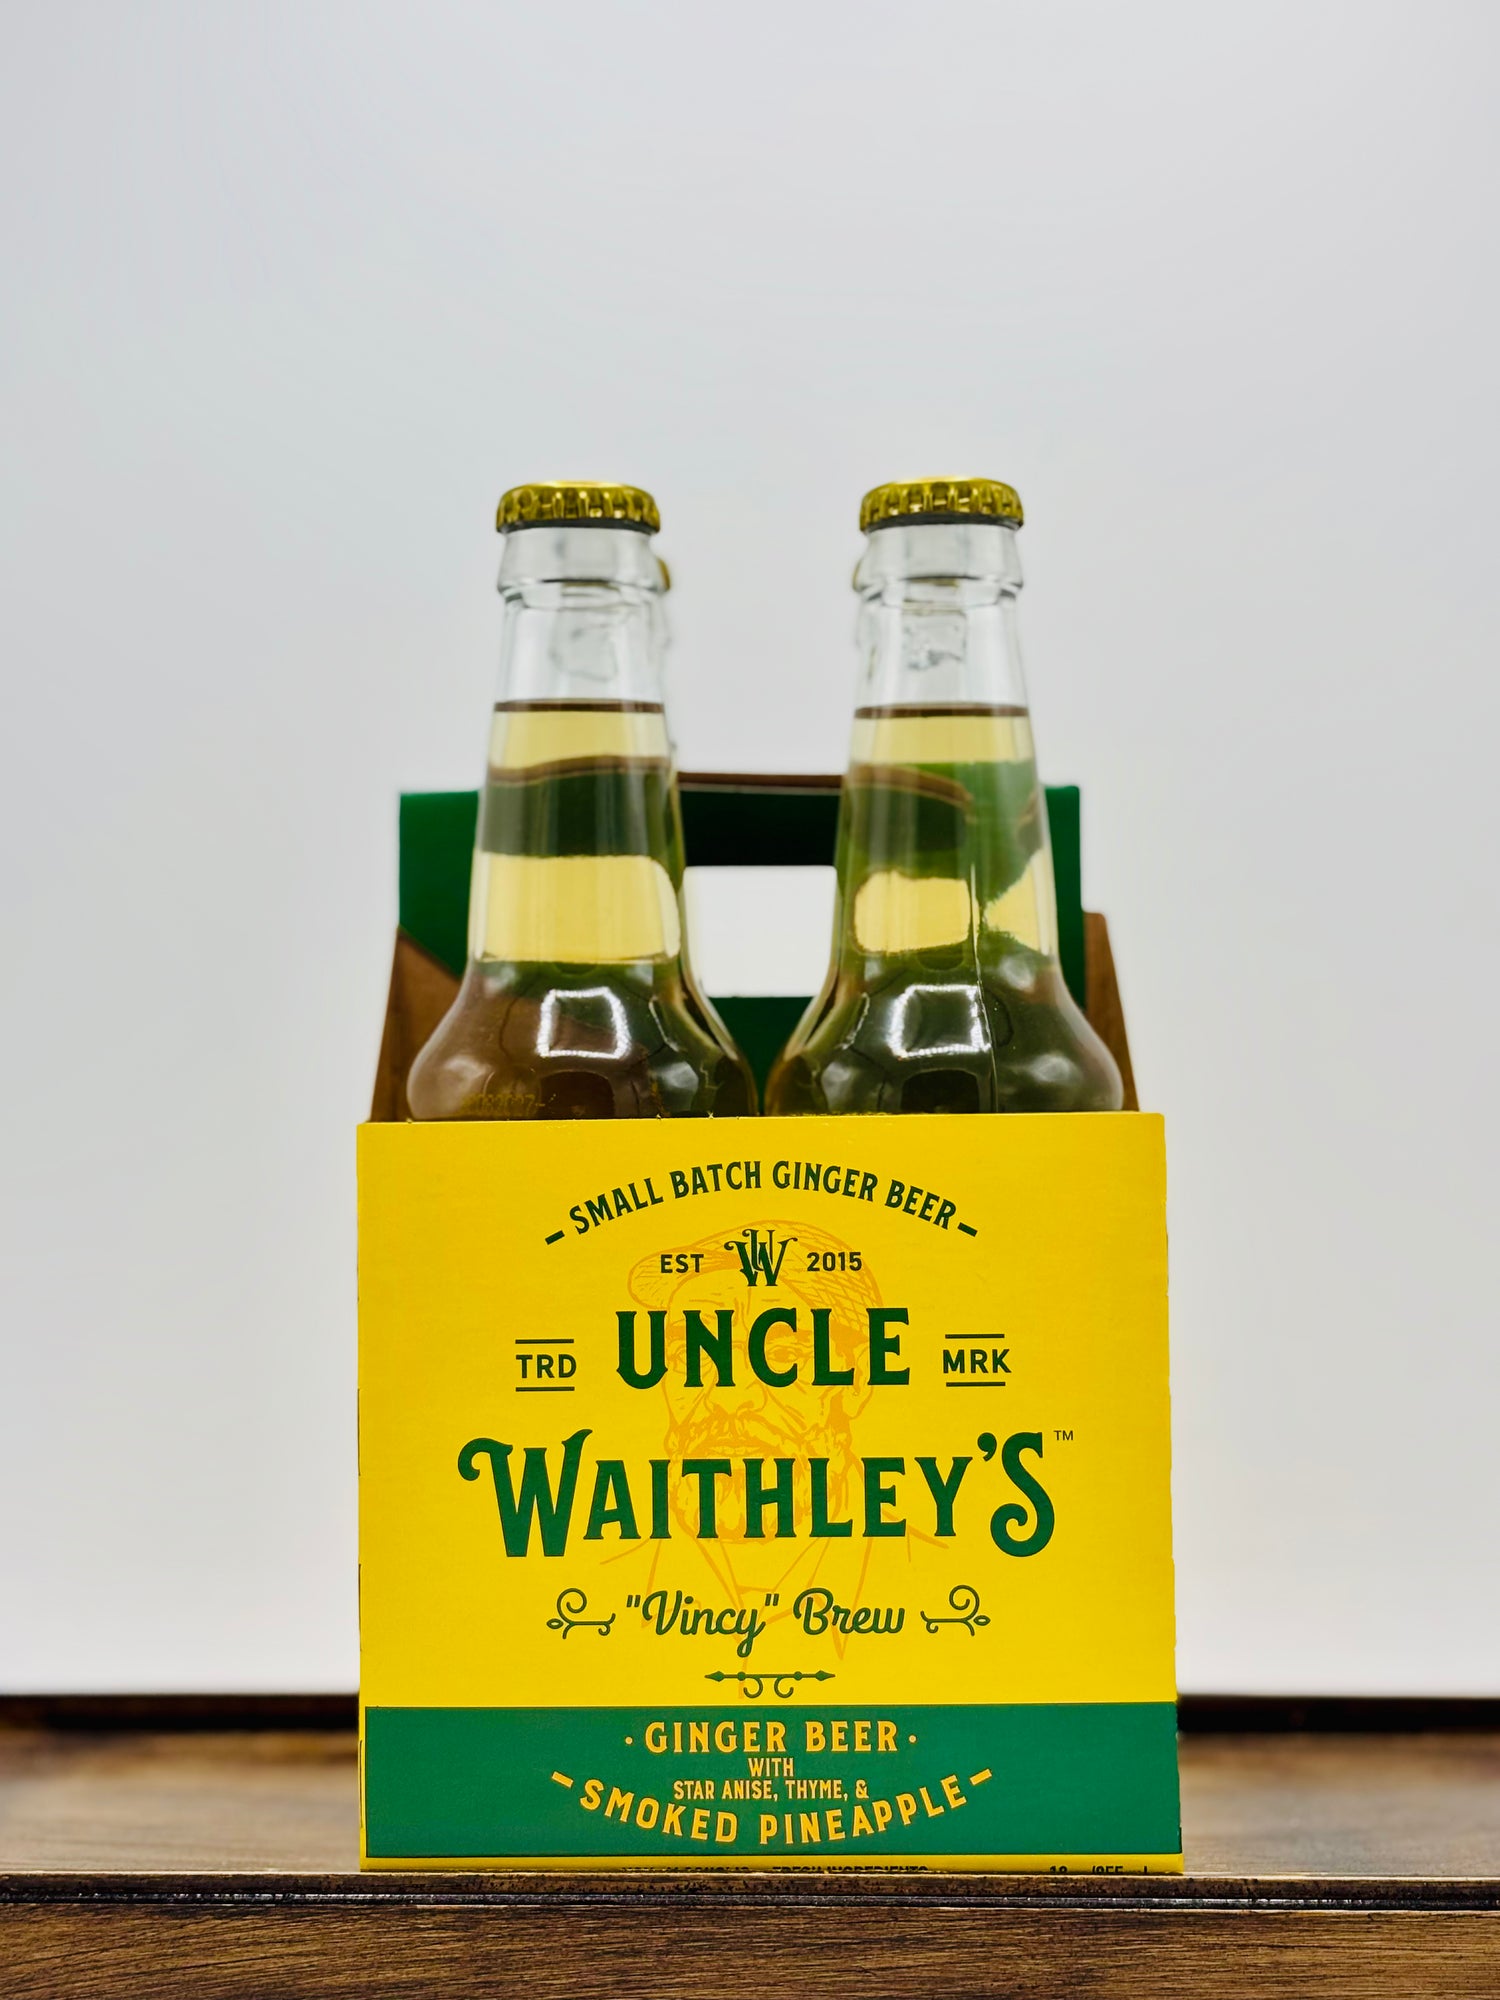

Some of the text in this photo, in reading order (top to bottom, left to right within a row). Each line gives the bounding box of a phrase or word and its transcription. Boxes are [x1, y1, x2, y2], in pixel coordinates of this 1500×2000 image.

[569, 1160, 957, 1235] SMALL BATCH GINGER BEER
[660, 1253, 705, 1274] EST
[806, 1251, 863, 1272] 2015
[615, 1307, 911, 1390] UNCLE
[942, 1348, 1012, 1374] MRK
[515, 1354, 577, 1379] TRD
[457, 1428, 1056, 1558] WAITHLEY'S
[626, 1587, 906, 1658] "Vincy" Brew
[645, 1720, 898, 1754] GINGER BEER
[747, 1757, 794, 1777] WITH
[673, 1779, 869, 1802] STAR ANISE, THYME, &
[579, 1774, 967, 1845] SMOKED PINEAPPLE
